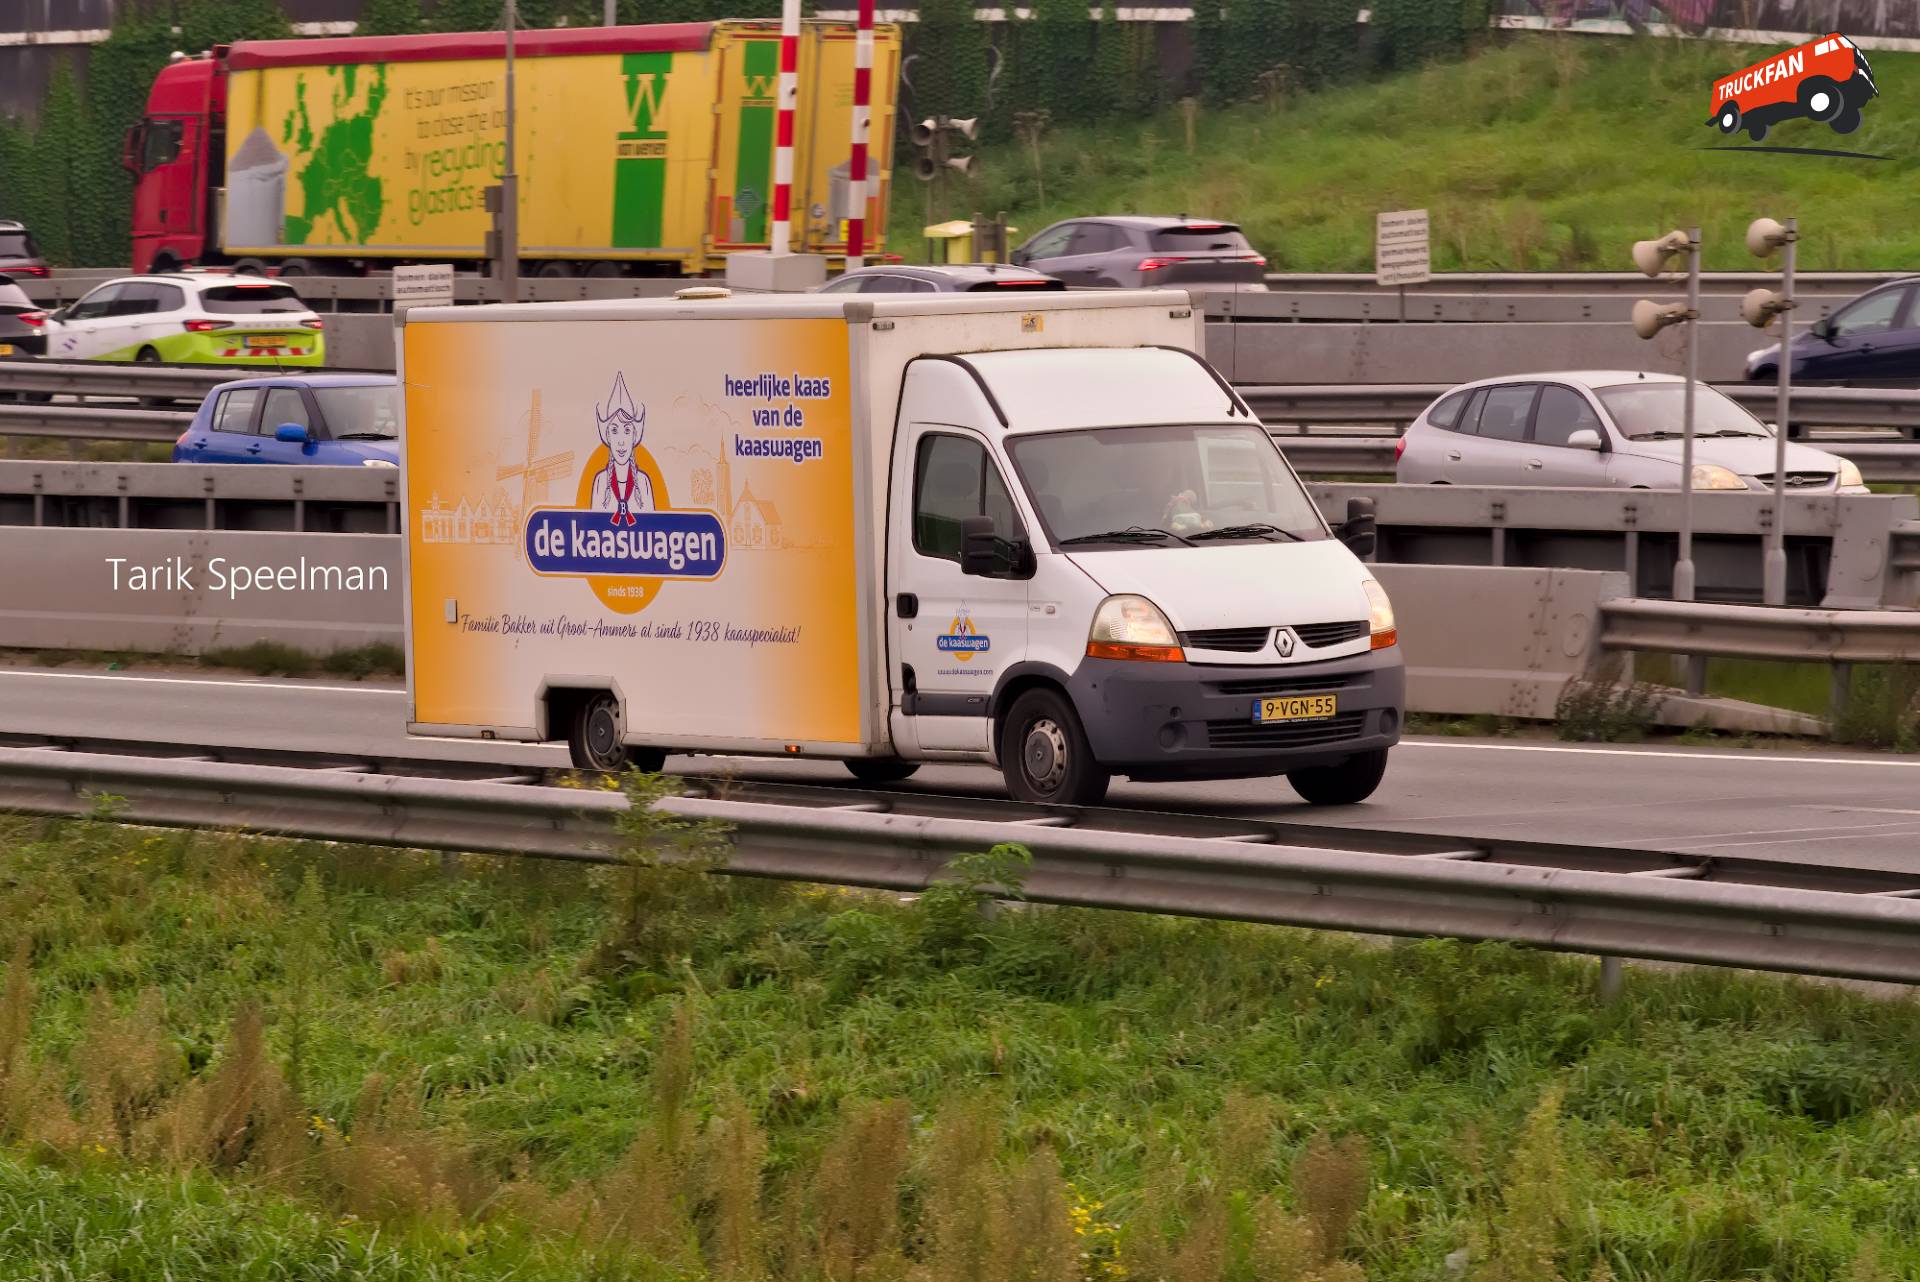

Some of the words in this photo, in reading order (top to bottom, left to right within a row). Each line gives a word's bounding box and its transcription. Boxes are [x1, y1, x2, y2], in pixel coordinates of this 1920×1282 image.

[725, 374, 791, 402] heerlijke
[794, 374, 830, 397] kaas
[752, 408, 779, 426] van
[783, 404, 802, 427] de
[735, 433, 822, 463] kaaswagen
[534, 519, 565, 557] de
[571, 519, 716, 570] kaaswagen
[607, 586, 626, 597] sinds
[627, 586, 644, 598] 1938
[461, 613, 500, 633] Familie
[501, 614, 537, 635] Bakker
[539, 618, 555, 634] uit
[557, 614, 638, 640] Groot-Ammers
[640, 620, 652, 638] al
[654, 620, 683, 639] sinds
[685, 620, 721, 642] 1938
[724, 622, 802, 648] kaasspecialist!
[939, 637, 948, 648] de
[949, 637, 989, 650] kaaswagen
[1265, 698, 1333, 717] 9-VGN-55
